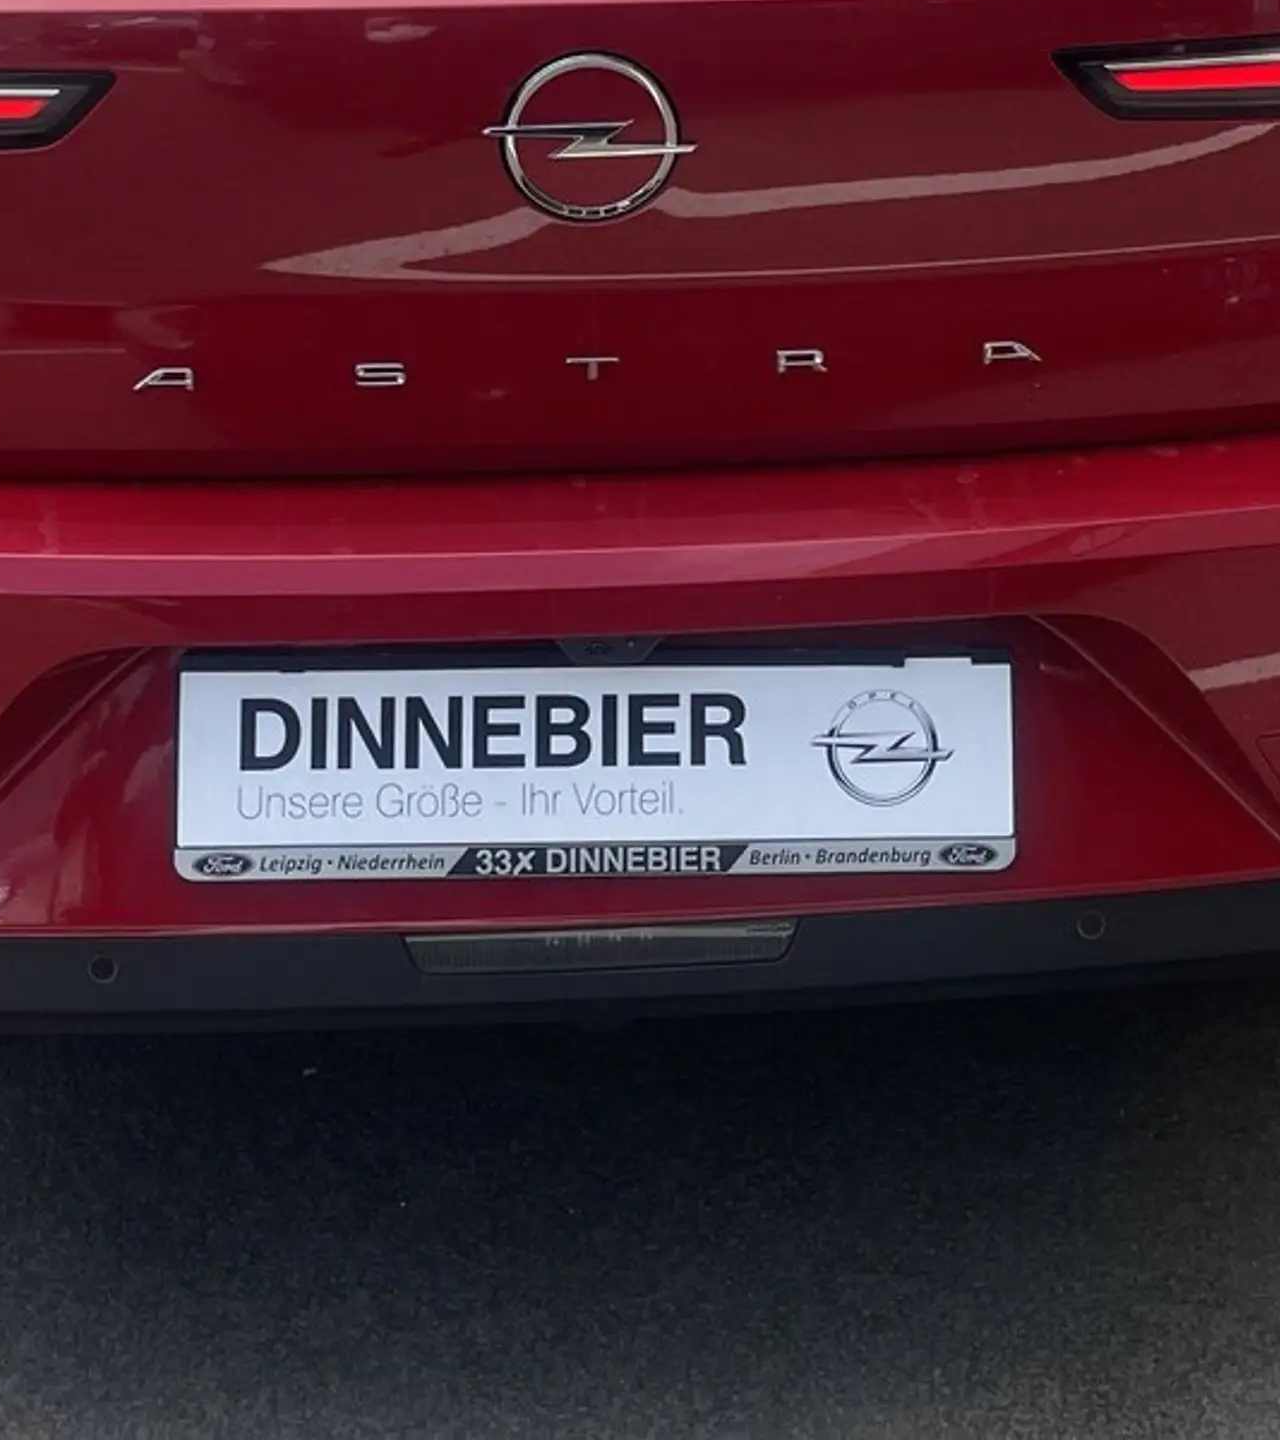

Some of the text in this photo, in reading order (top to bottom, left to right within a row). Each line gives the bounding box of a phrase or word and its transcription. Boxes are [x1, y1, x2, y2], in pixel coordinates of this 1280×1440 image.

[133, 340, 1043, 392] ASTRA
[238, 693, 747, 772] DINNEBIER
[237, 785, 363, 820] Unsere
[375, 782, 483, 818] Größe
[521, 781, 562, 817] Ihr
[572, 781, 683, 816] Vorteil.
[200, 854, 246, 875] Ford
[259, 856, 321, 875] Leipzig
[337, 853, 446, 870] Niederrhein
[545, 847, 721, 873] DINNEBIER
[749, 848, 801, 865] Berlin
[815, 845, 932, 866] Brandenburg
